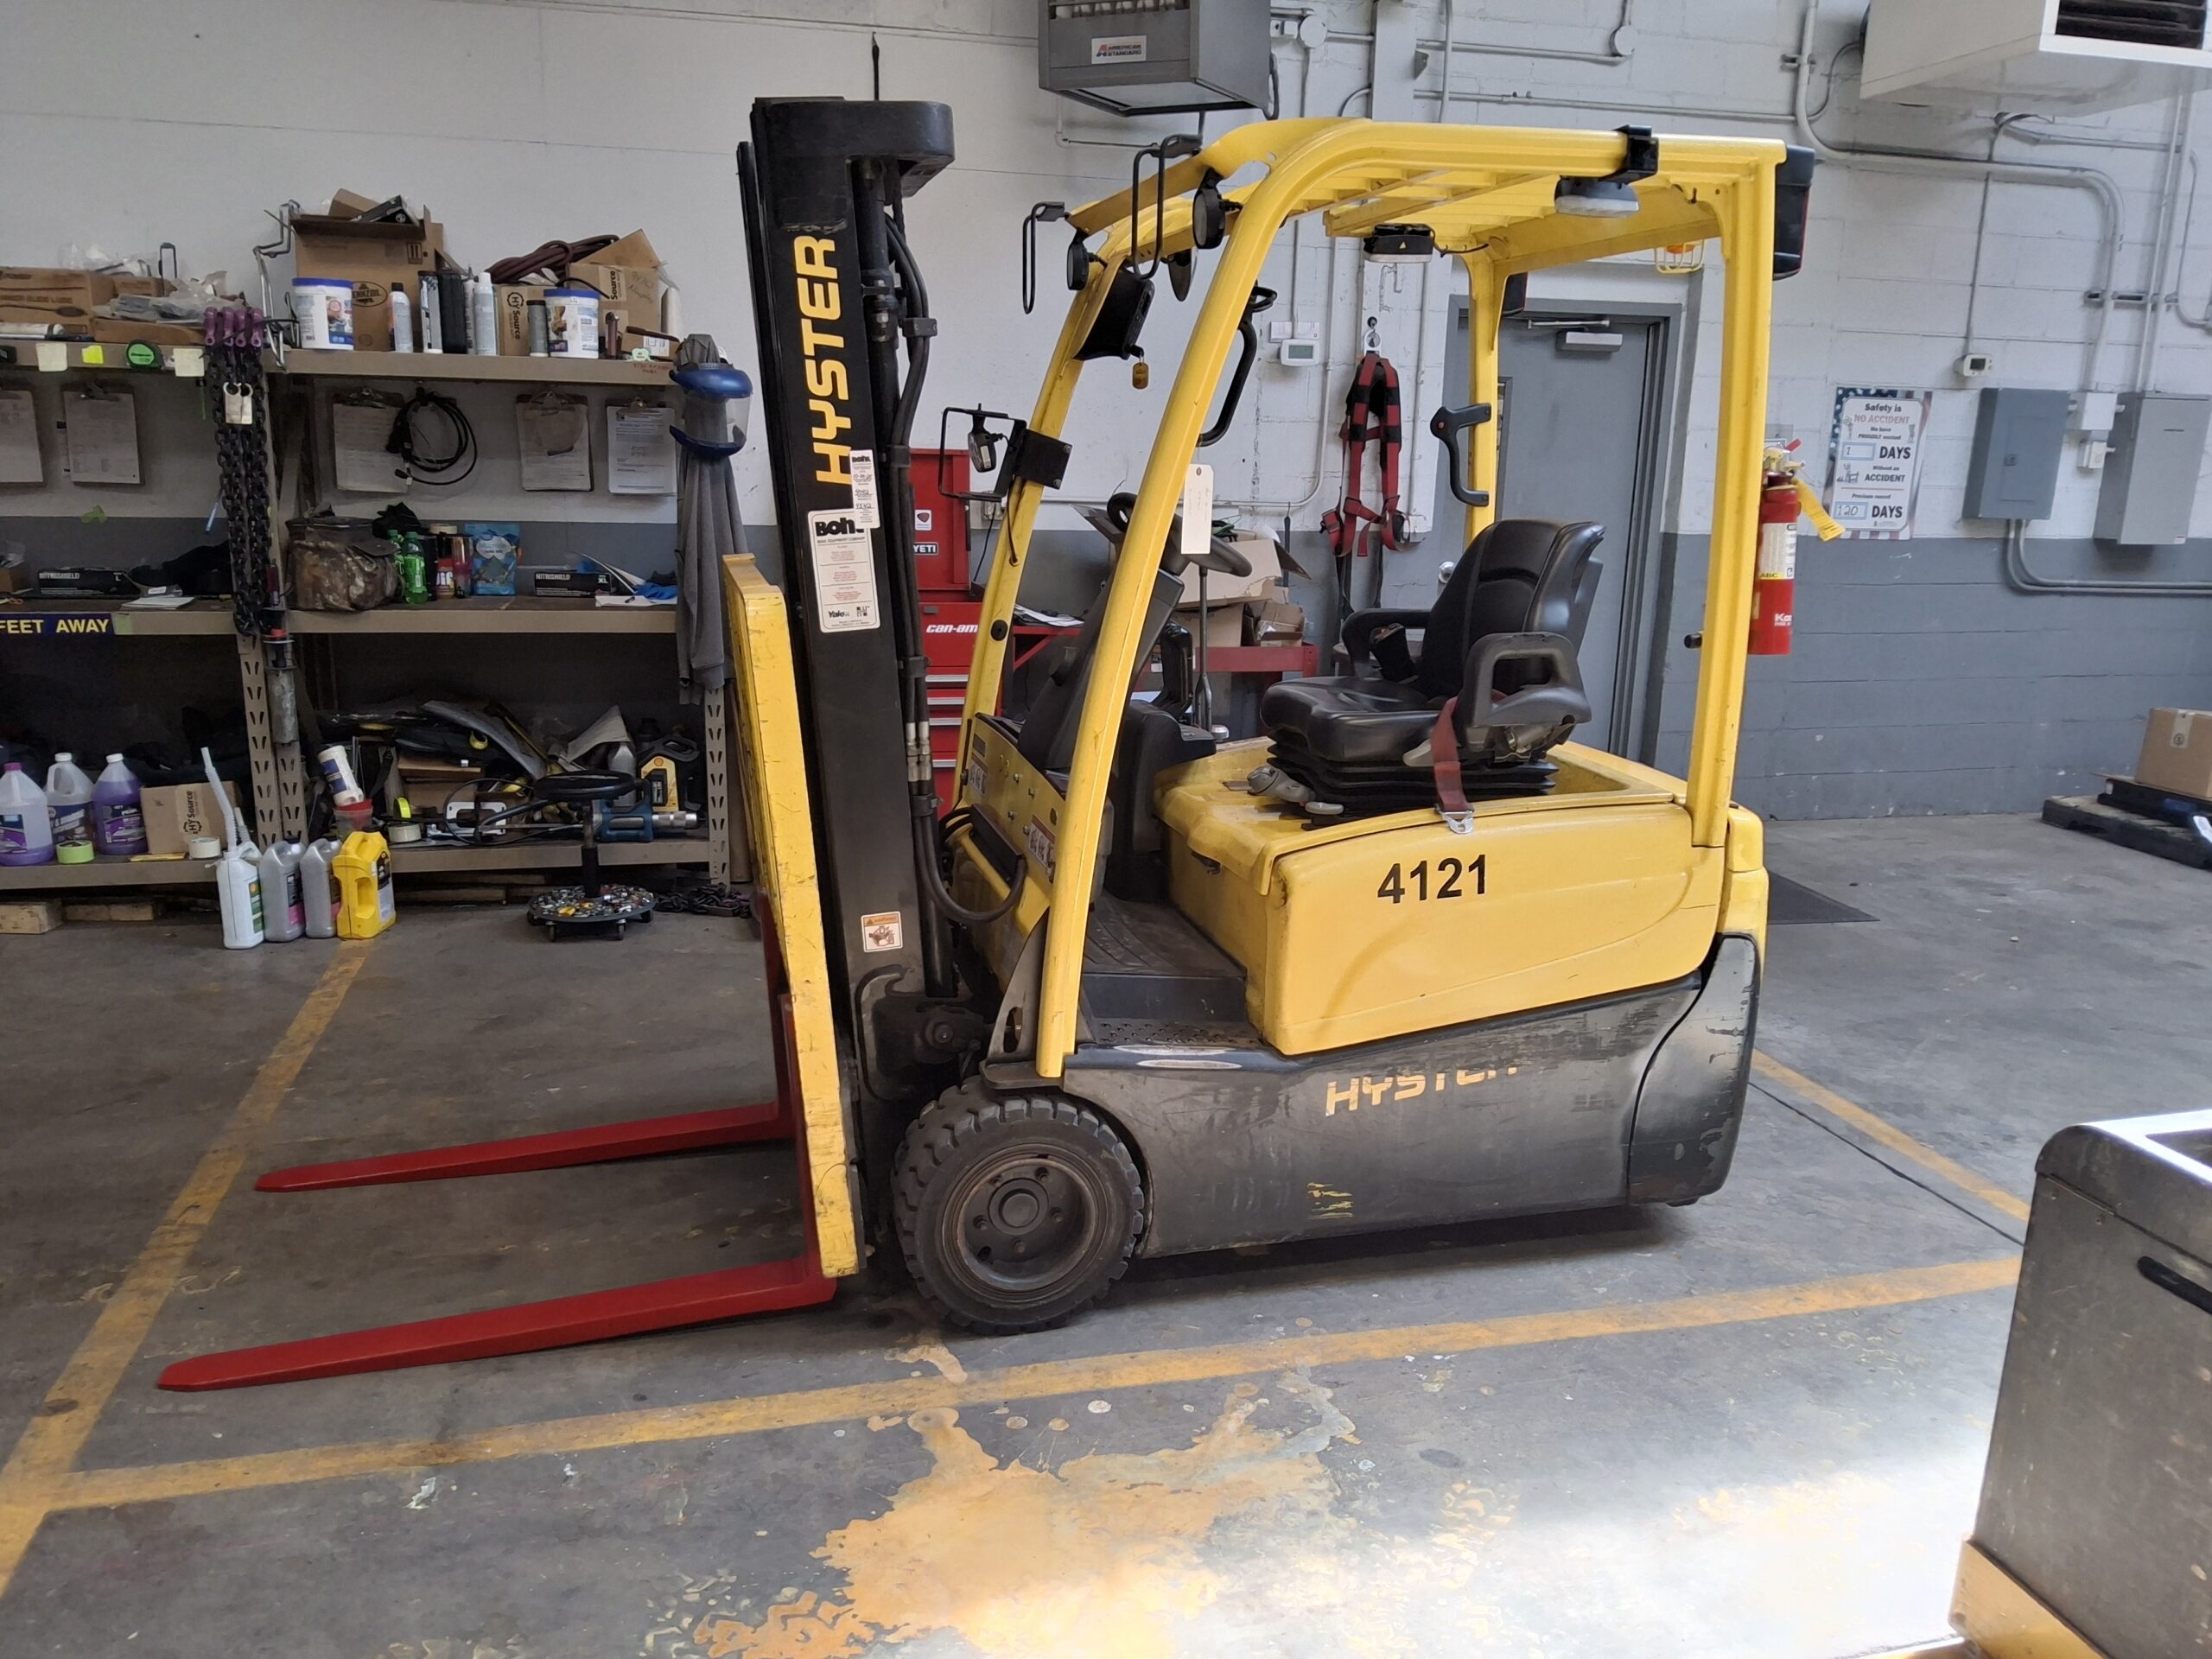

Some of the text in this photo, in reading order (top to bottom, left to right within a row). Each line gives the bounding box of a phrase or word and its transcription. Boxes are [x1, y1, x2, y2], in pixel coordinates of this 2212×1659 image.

[793, 234, 852, 485] HYSTER
[1865, 403, 1902, 414] Safety is
[1868, 415, 1910, 424] ACCIDENT
[1879, 446, 1911, 460] DAYS
[1864, 474, 1905, 482] ACCIDENT
[1838, 505, 1859, 516] 120
[1872, 505, 1904, 518] DAYS
[913, 544, 936, 553] YETI
[0, 619, 109, 633] FEET AWAY
[926, 624, 978, 633] can-am
[187, 791, 195, 818] Source
[1377, 854, 1486, 904] 4121
